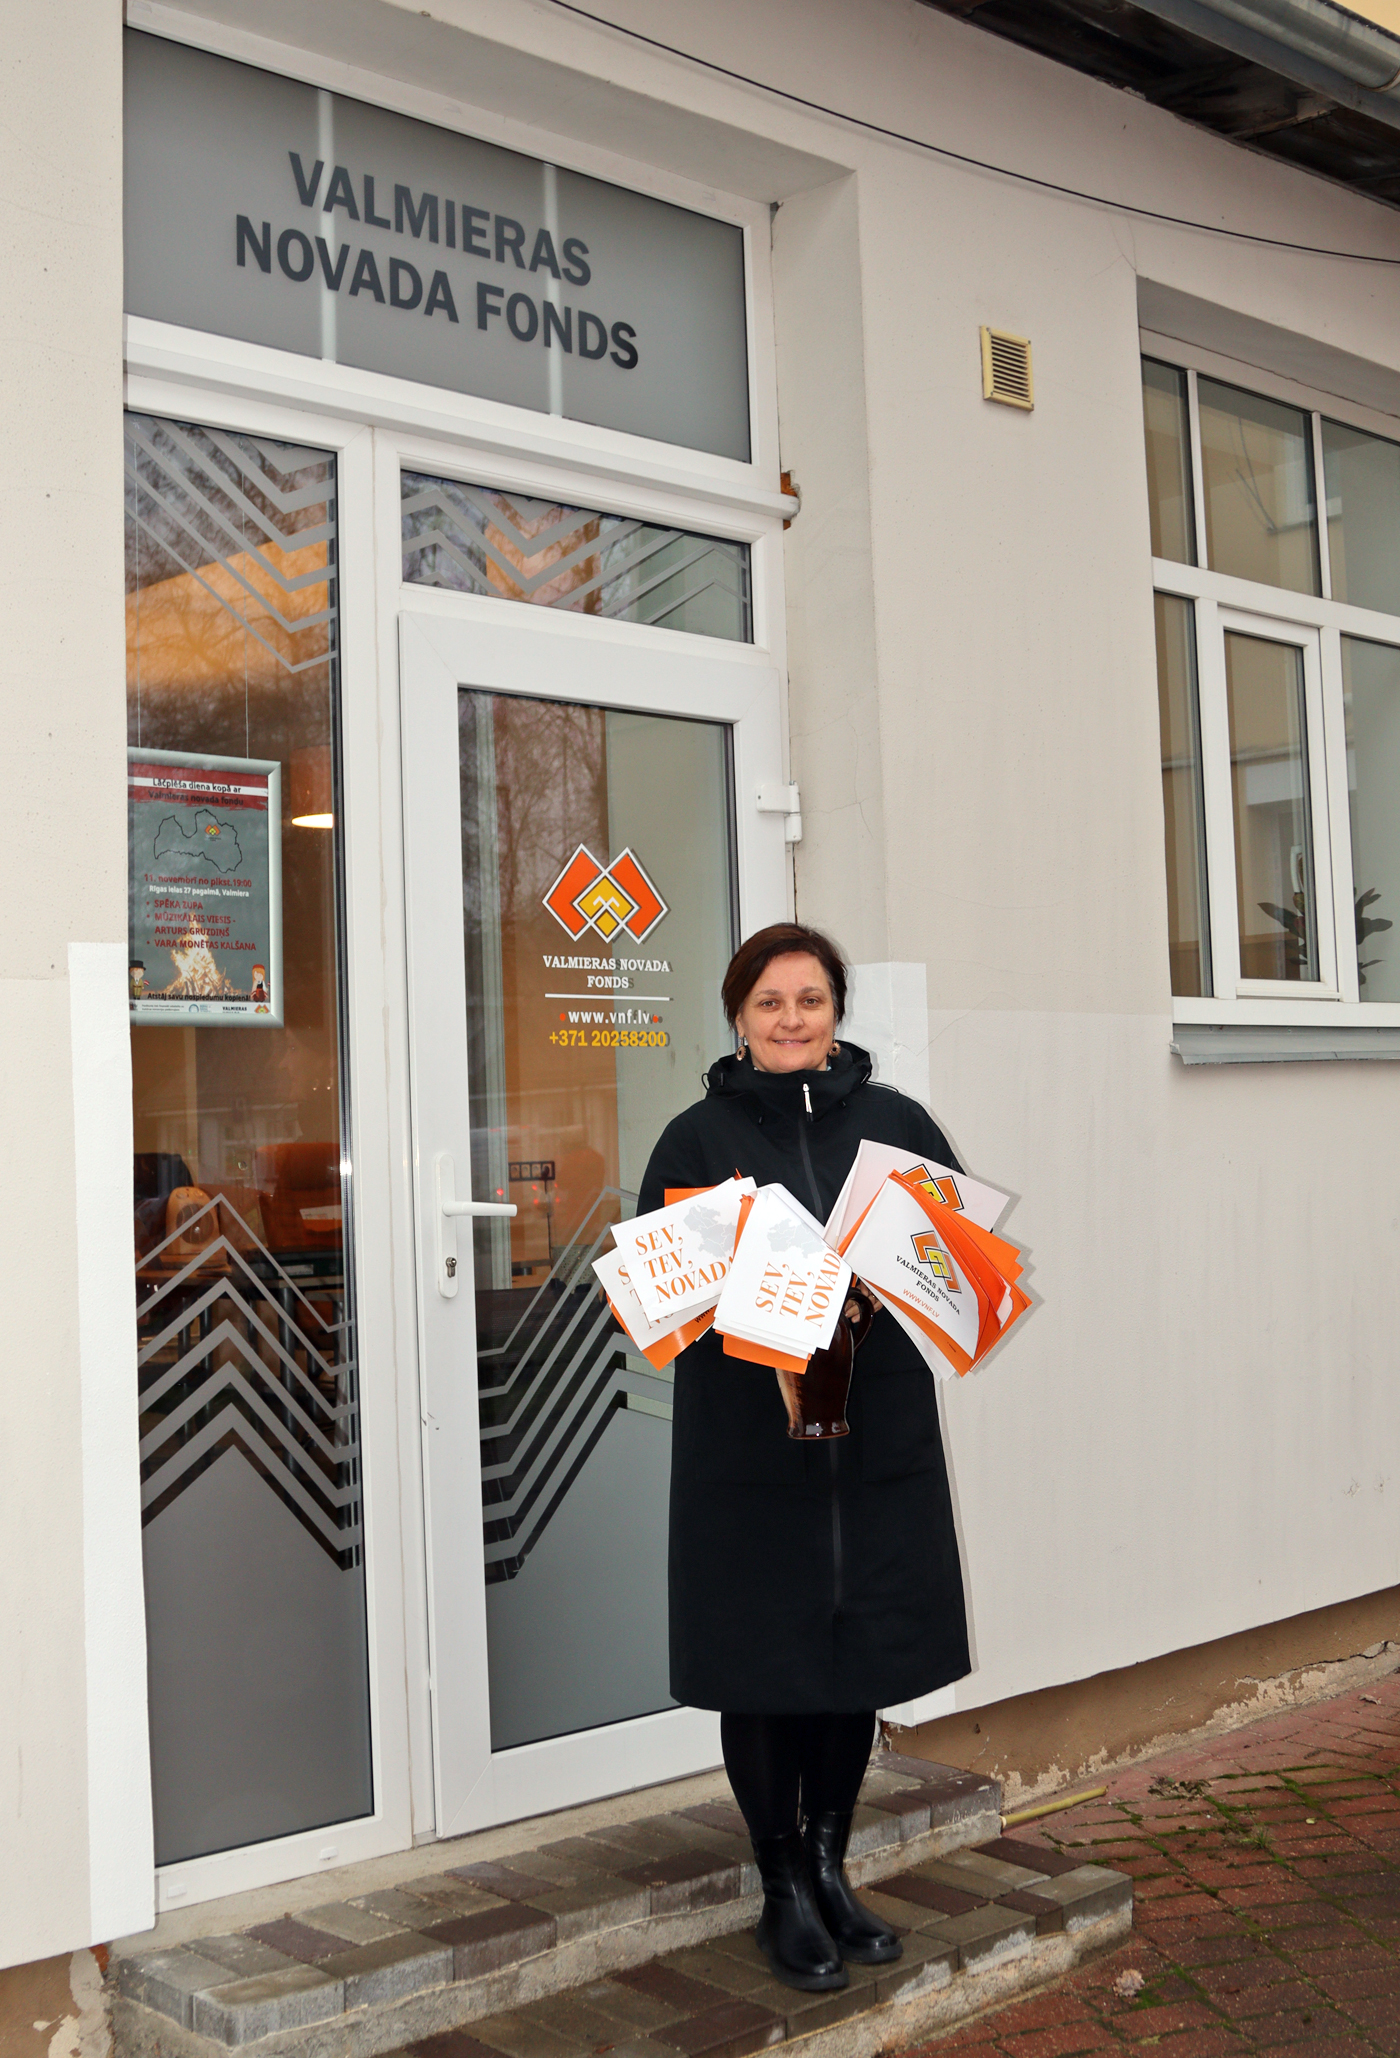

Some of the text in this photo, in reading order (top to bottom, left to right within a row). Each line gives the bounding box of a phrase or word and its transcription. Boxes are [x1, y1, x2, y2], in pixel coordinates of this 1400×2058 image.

[288, 150, 592, 287] VALMIERAS
[235, 214, 639, 370] NOVADA FONDS
[188, 781, 211, 791] diena
[212, 783, 231, 793] kopā
[148, 790, 244, 806] Valmieras novada fondu
[158, 875, 197, 885] novembrī
[149, 885, 167, 894] Rīgas
[168, 885, 183, 894] ielas
[221, 889, 249, 898] Valmiera
[154, 898, 203, 910] SPĒKA ZUPA
[154, 911, 205, 923] MŪZIKĀLAIS
[206, 915, 231, 924] VIESIS
[154, 926, 187, 935] ARTURS
[154, 939, 256, 951] VARA MONĒTAS KALŠANA
[542, 955, 670, 972] VALMIERAS NOVADA
[587, 975, 630, 989] FONDS
[567, 1008, 651, 1024] www.vnf.lv
[549, 1029, 667, 1047] +371 20258200
[635, 1223, 684, 1256] SEV,
[643, 1248, 693, 1279] TEV,
[755, 1261, 790, 1314] SEV,
[896, 1255, 960, 1315] VALMIERAS NOVADA
[916, 1280, 940, 1302] FONDS
[779, 1270, 815, 1318] TEV,
[903, 1288, 940, 1318] WWW.VNF.LV
